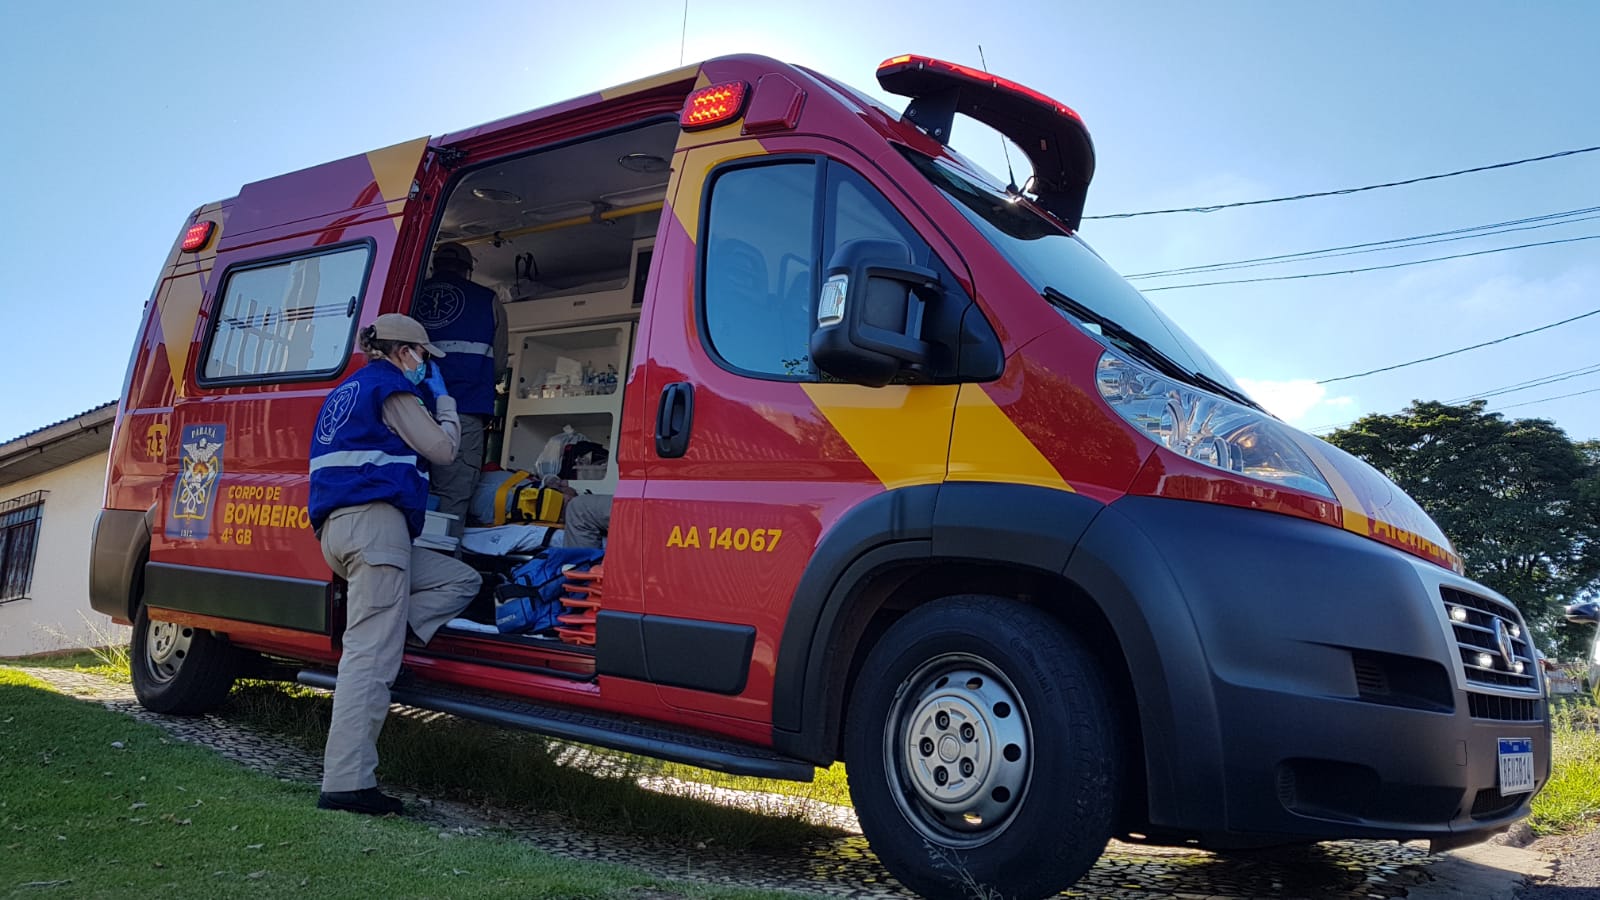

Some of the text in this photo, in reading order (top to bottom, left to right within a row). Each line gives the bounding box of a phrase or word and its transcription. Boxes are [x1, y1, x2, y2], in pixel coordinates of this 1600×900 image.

[191, 426, 217, 439] PARANÁ
[147, 437, 164, 457] 193
[228, 484, 282, 501] CORPO DE
[235, 528, 252, 545] GB
[666, 525, 782, 552] AA 14067
